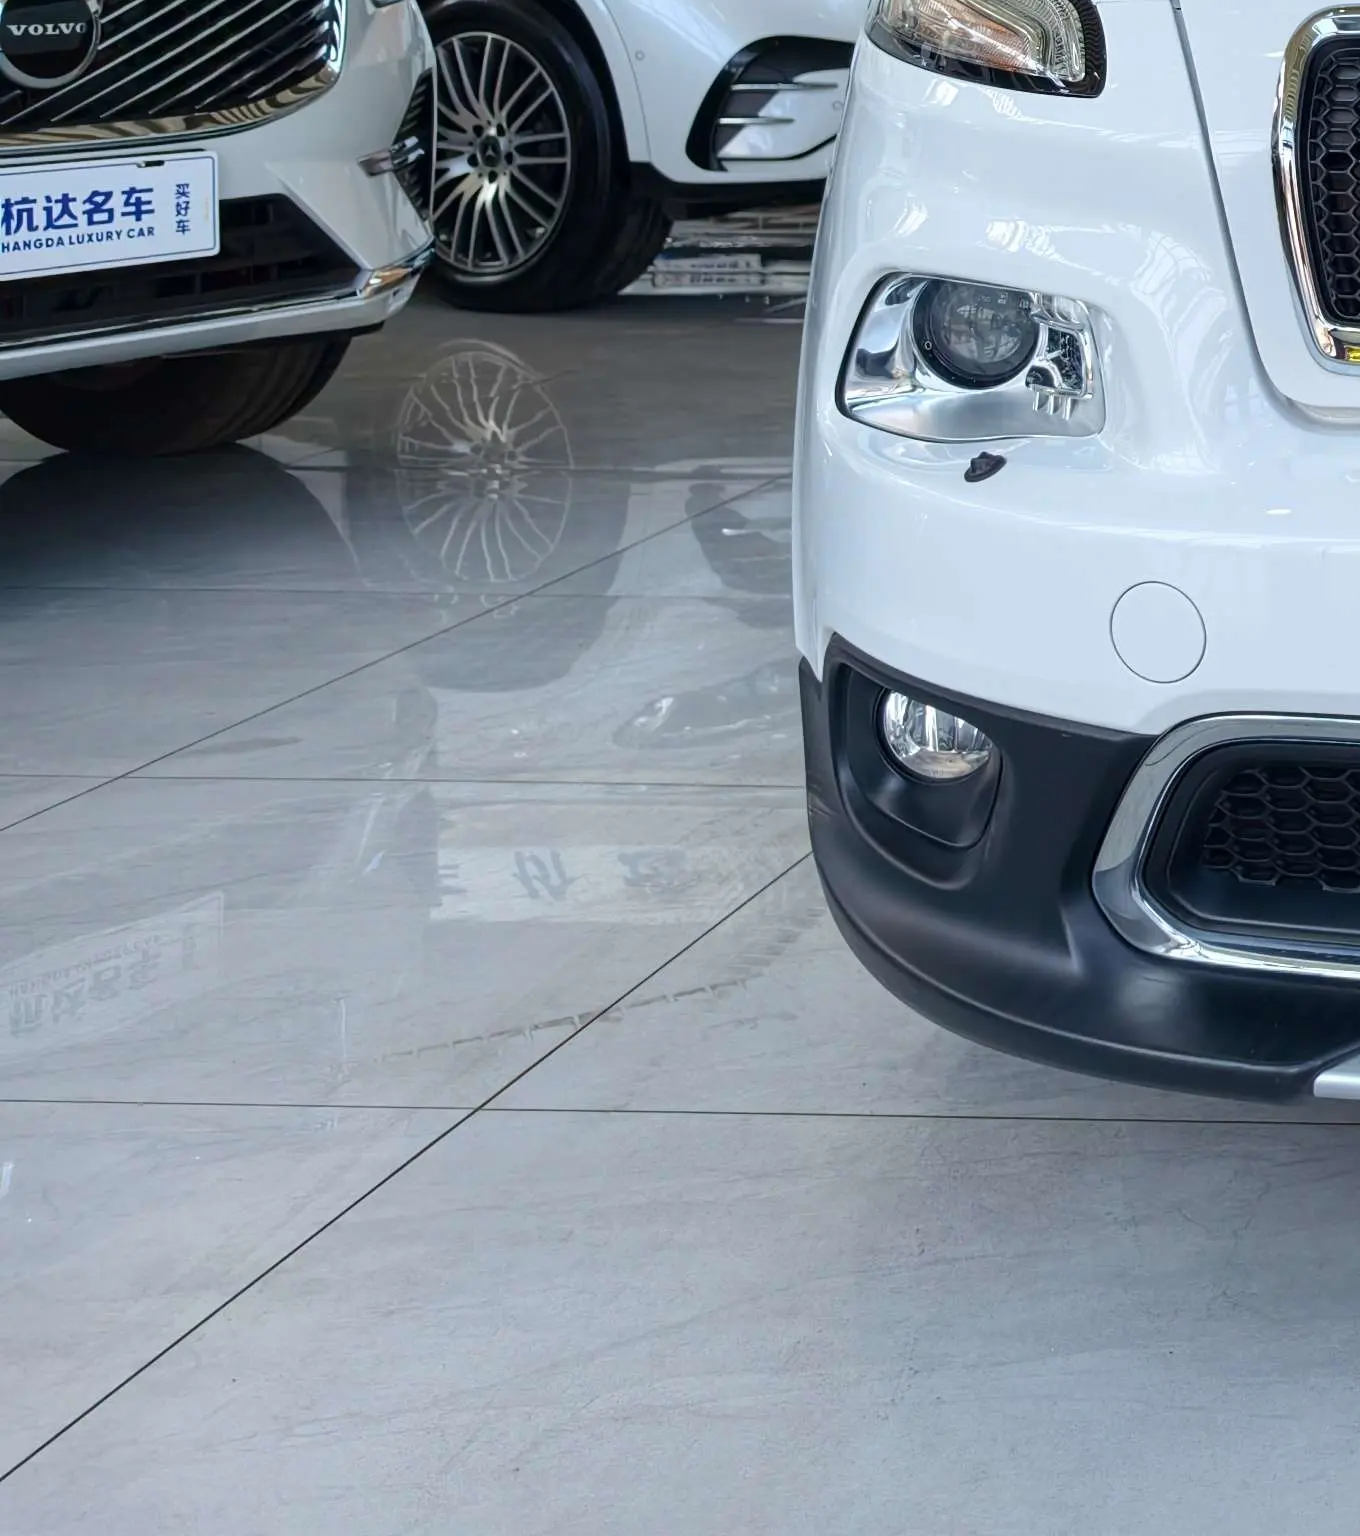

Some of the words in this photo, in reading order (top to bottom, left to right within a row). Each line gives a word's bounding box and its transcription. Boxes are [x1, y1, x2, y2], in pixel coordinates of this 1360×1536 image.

[6, 22, 88, 37] VOLVO
[1, 186, 156, 237] 杭达名车
[175, 183, 191, 235] 买好车
[1, 236, 65, 253] HANGDA
[69, 229, 123, 246] LUXURY
[127, 226, 156, 239] CAR
